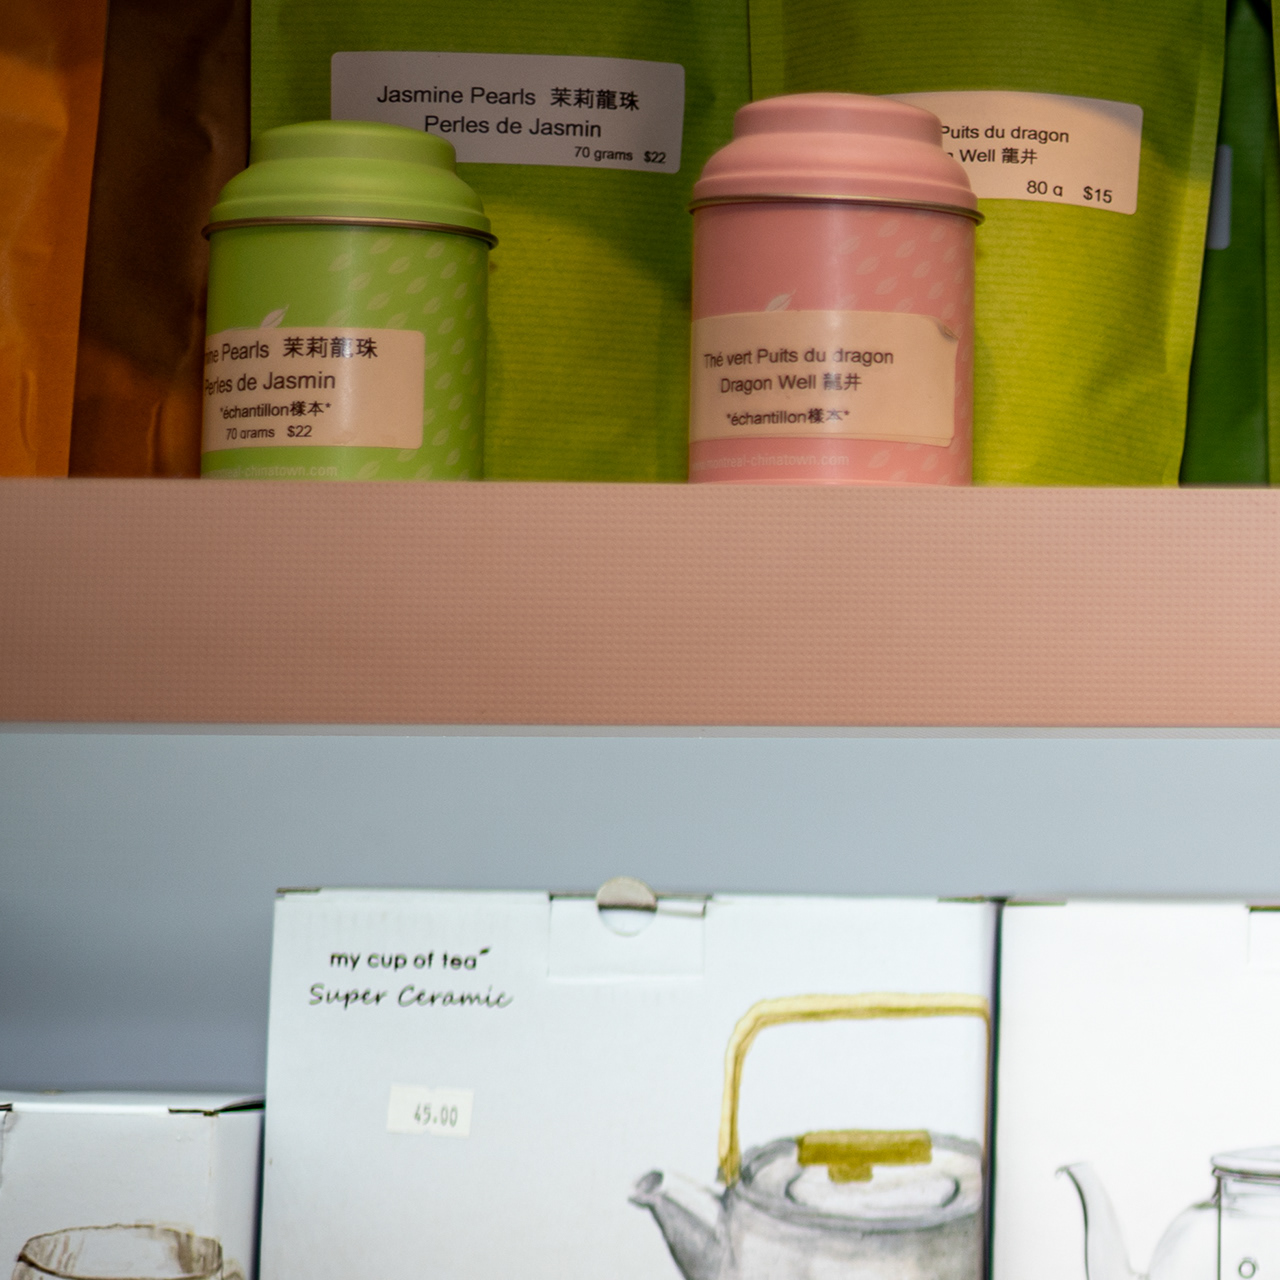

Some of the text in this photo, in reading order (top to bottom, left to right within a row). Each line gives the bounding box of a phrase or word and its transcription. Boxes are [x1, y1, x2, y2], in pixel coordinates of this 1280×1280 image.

[377, 86, 640, 111] Jasmine Pearls 茉莉龍珠
[425, 115, 602, 137] Perles de Jasmin
[941, 125, 1069, 144] Puits du dragon
[574, 147, 666, 164] 70 grams $22
[959, 147, 1038, 165] Well 龍井
[1026, 180, 1113, 204] 80 $15
[222, 341, 269, 361] Pearls
[704, 348, 894, 369] Thé vert Puits du dragon
[237, 371, 336, 391] de Jasmin
[721, 377, 772, 395] Dragon
[778, 374, 817, 390] Well
[226, 425, 312, 440] 70 $22
[330, 949, 477, 972] my cup of tea
[308, 982, 514, 1010] Super Ceramic
[413, 1102, 459, 1127] 45.00
